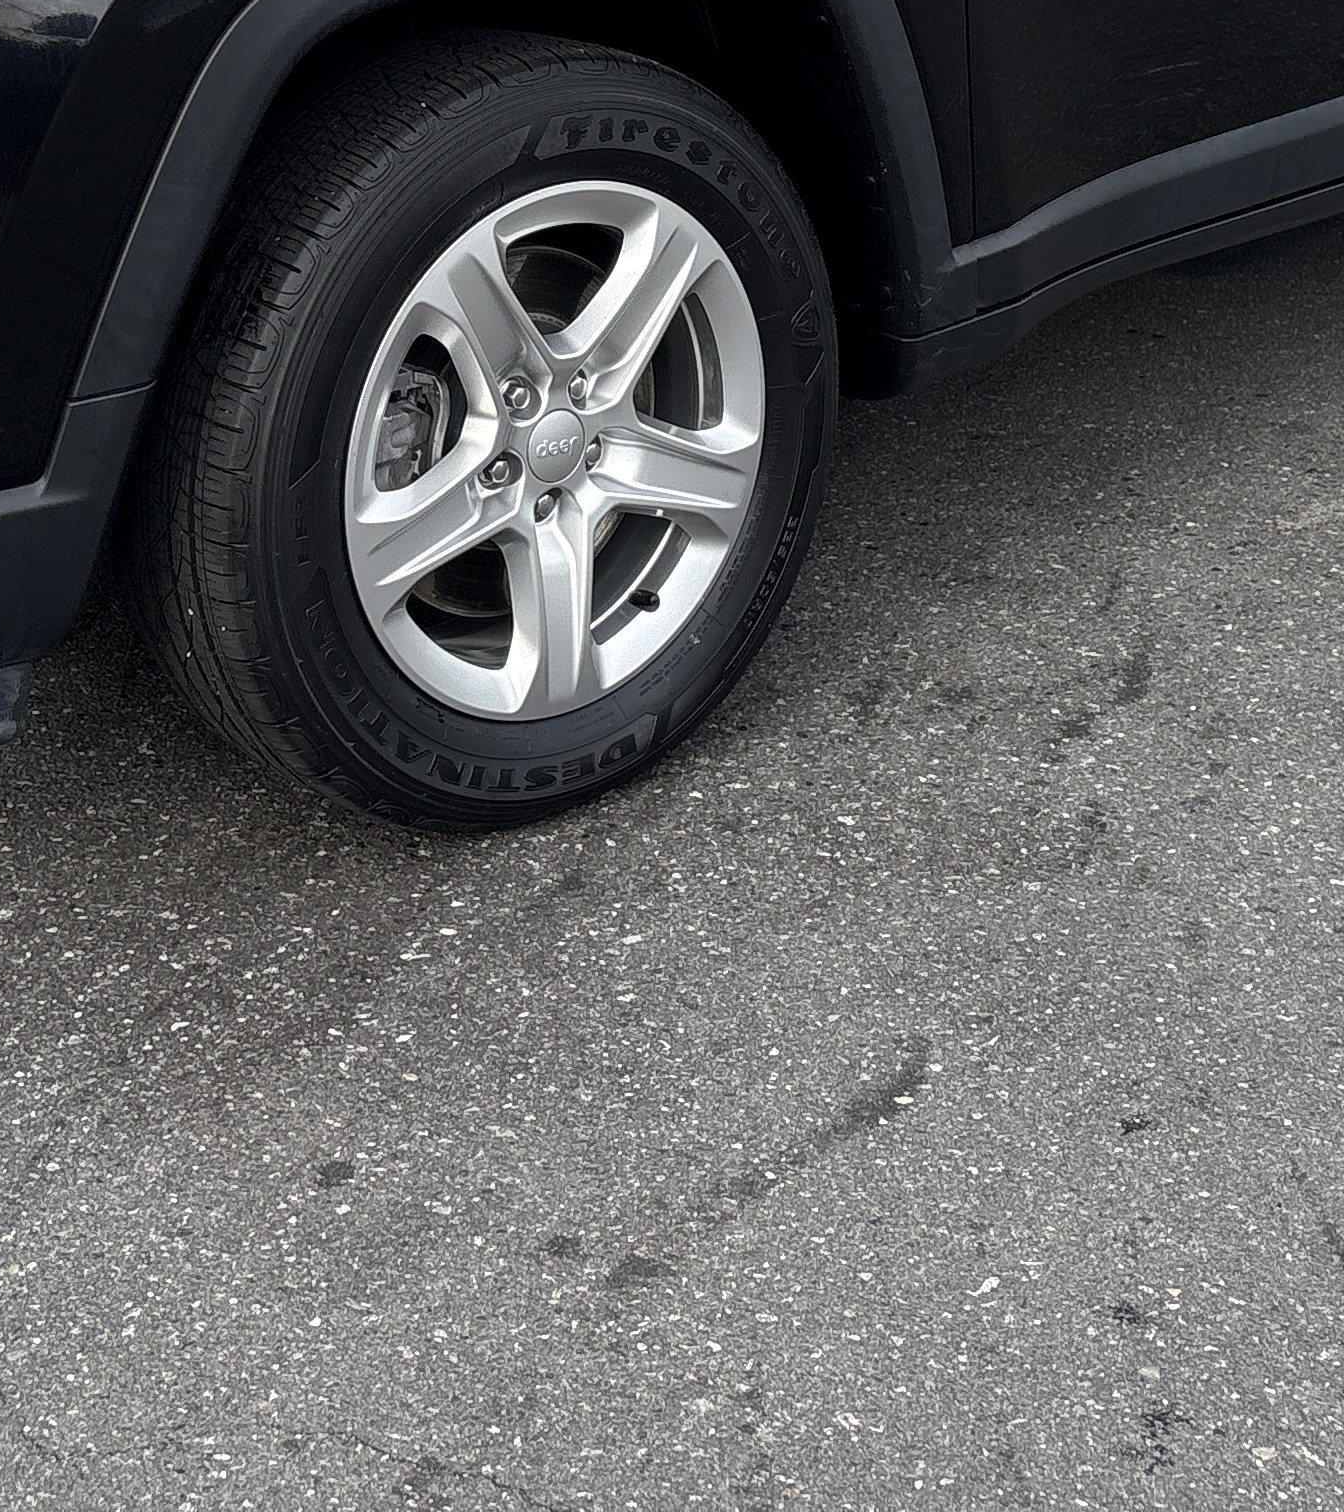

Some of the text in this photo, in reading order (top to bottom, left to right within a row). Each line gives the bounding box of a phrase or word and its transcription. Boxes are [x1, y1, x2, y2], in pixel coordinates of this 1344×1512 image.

[560, 116, 802, 280] Firestone
[536, 435, 578, 457] Jeep
[305, 599, 639, 793] DESTINATION
